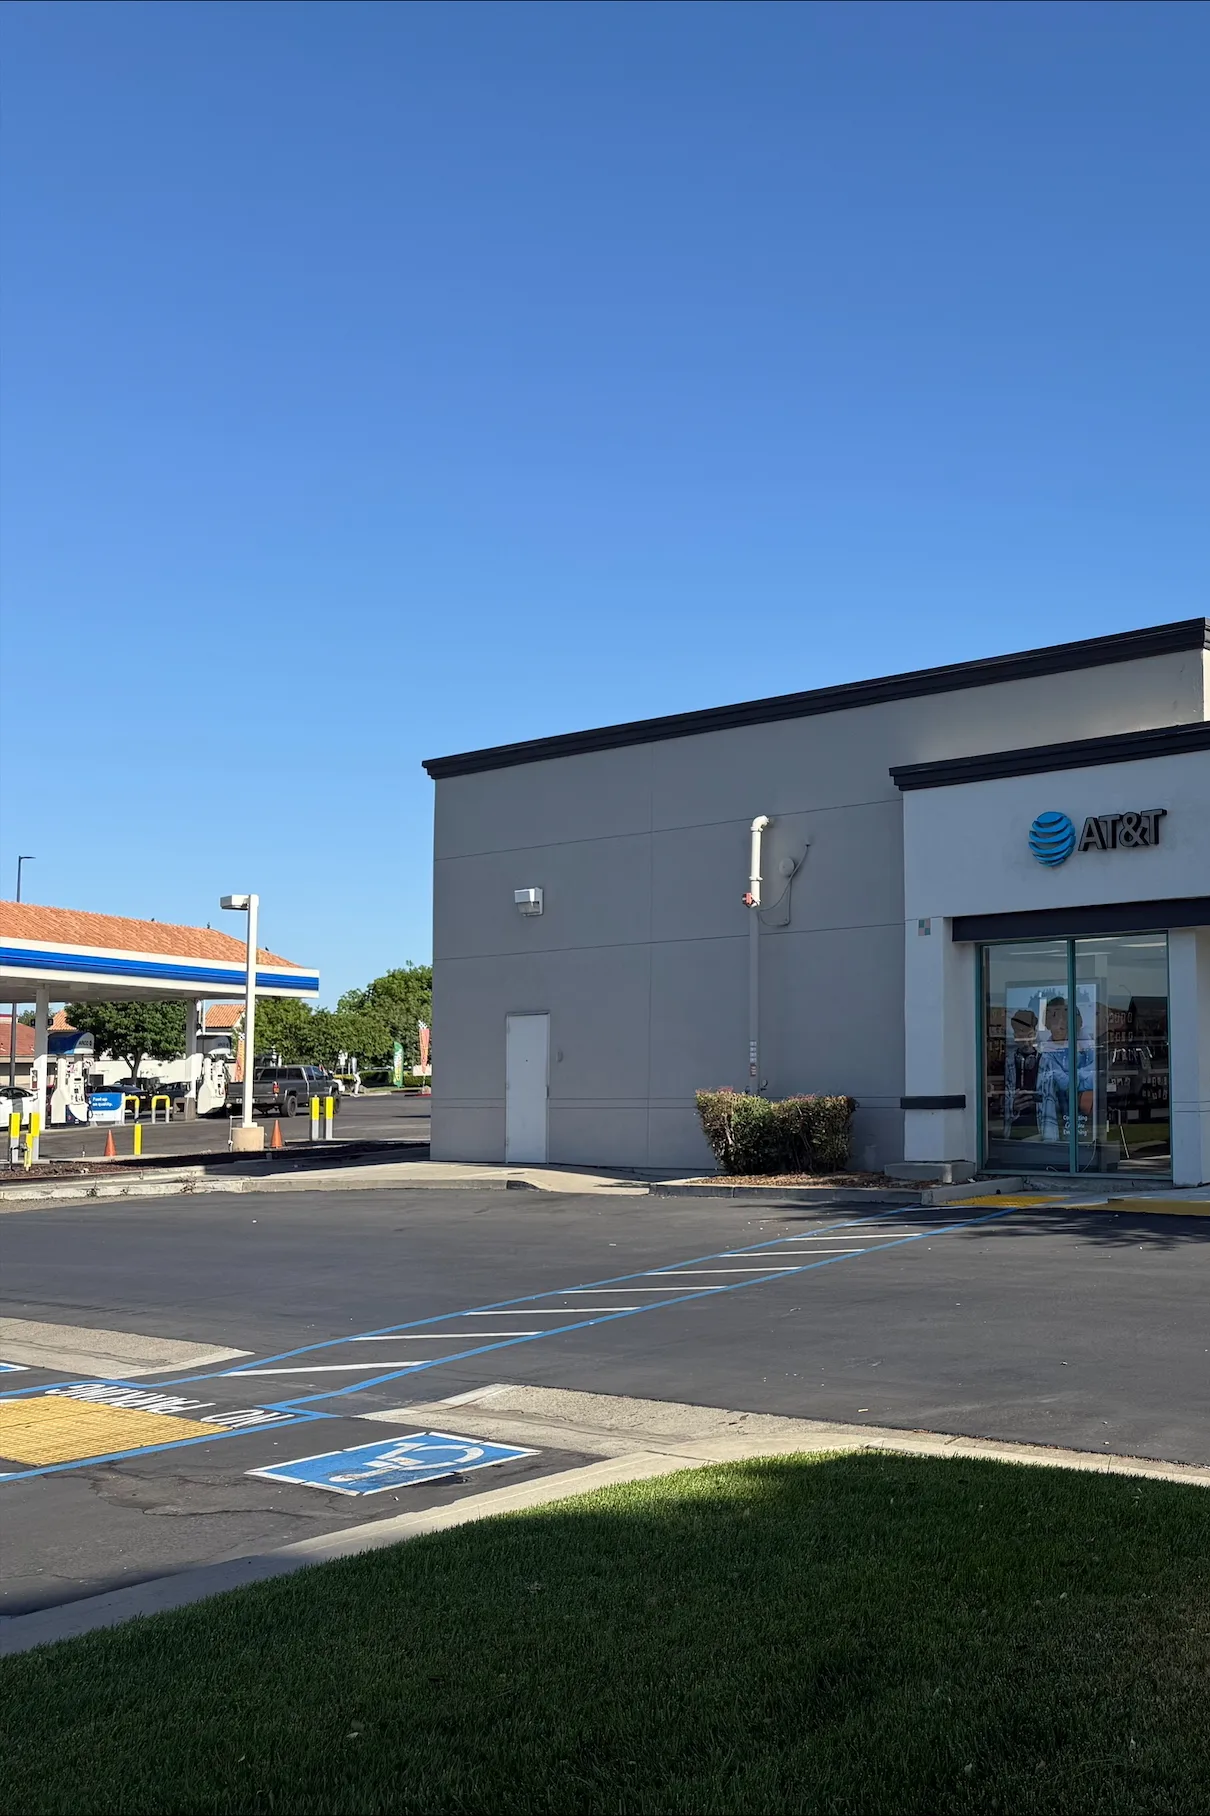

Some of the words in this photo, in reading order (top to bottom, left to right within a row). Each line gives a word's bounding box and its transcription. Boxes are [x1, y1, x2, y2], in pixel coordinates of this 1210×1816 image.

[1078, 789, 1167, 851] AT&T
[45, 1383, 216, 1415] PARKING
[200, 1409, 296, 1429] NO
